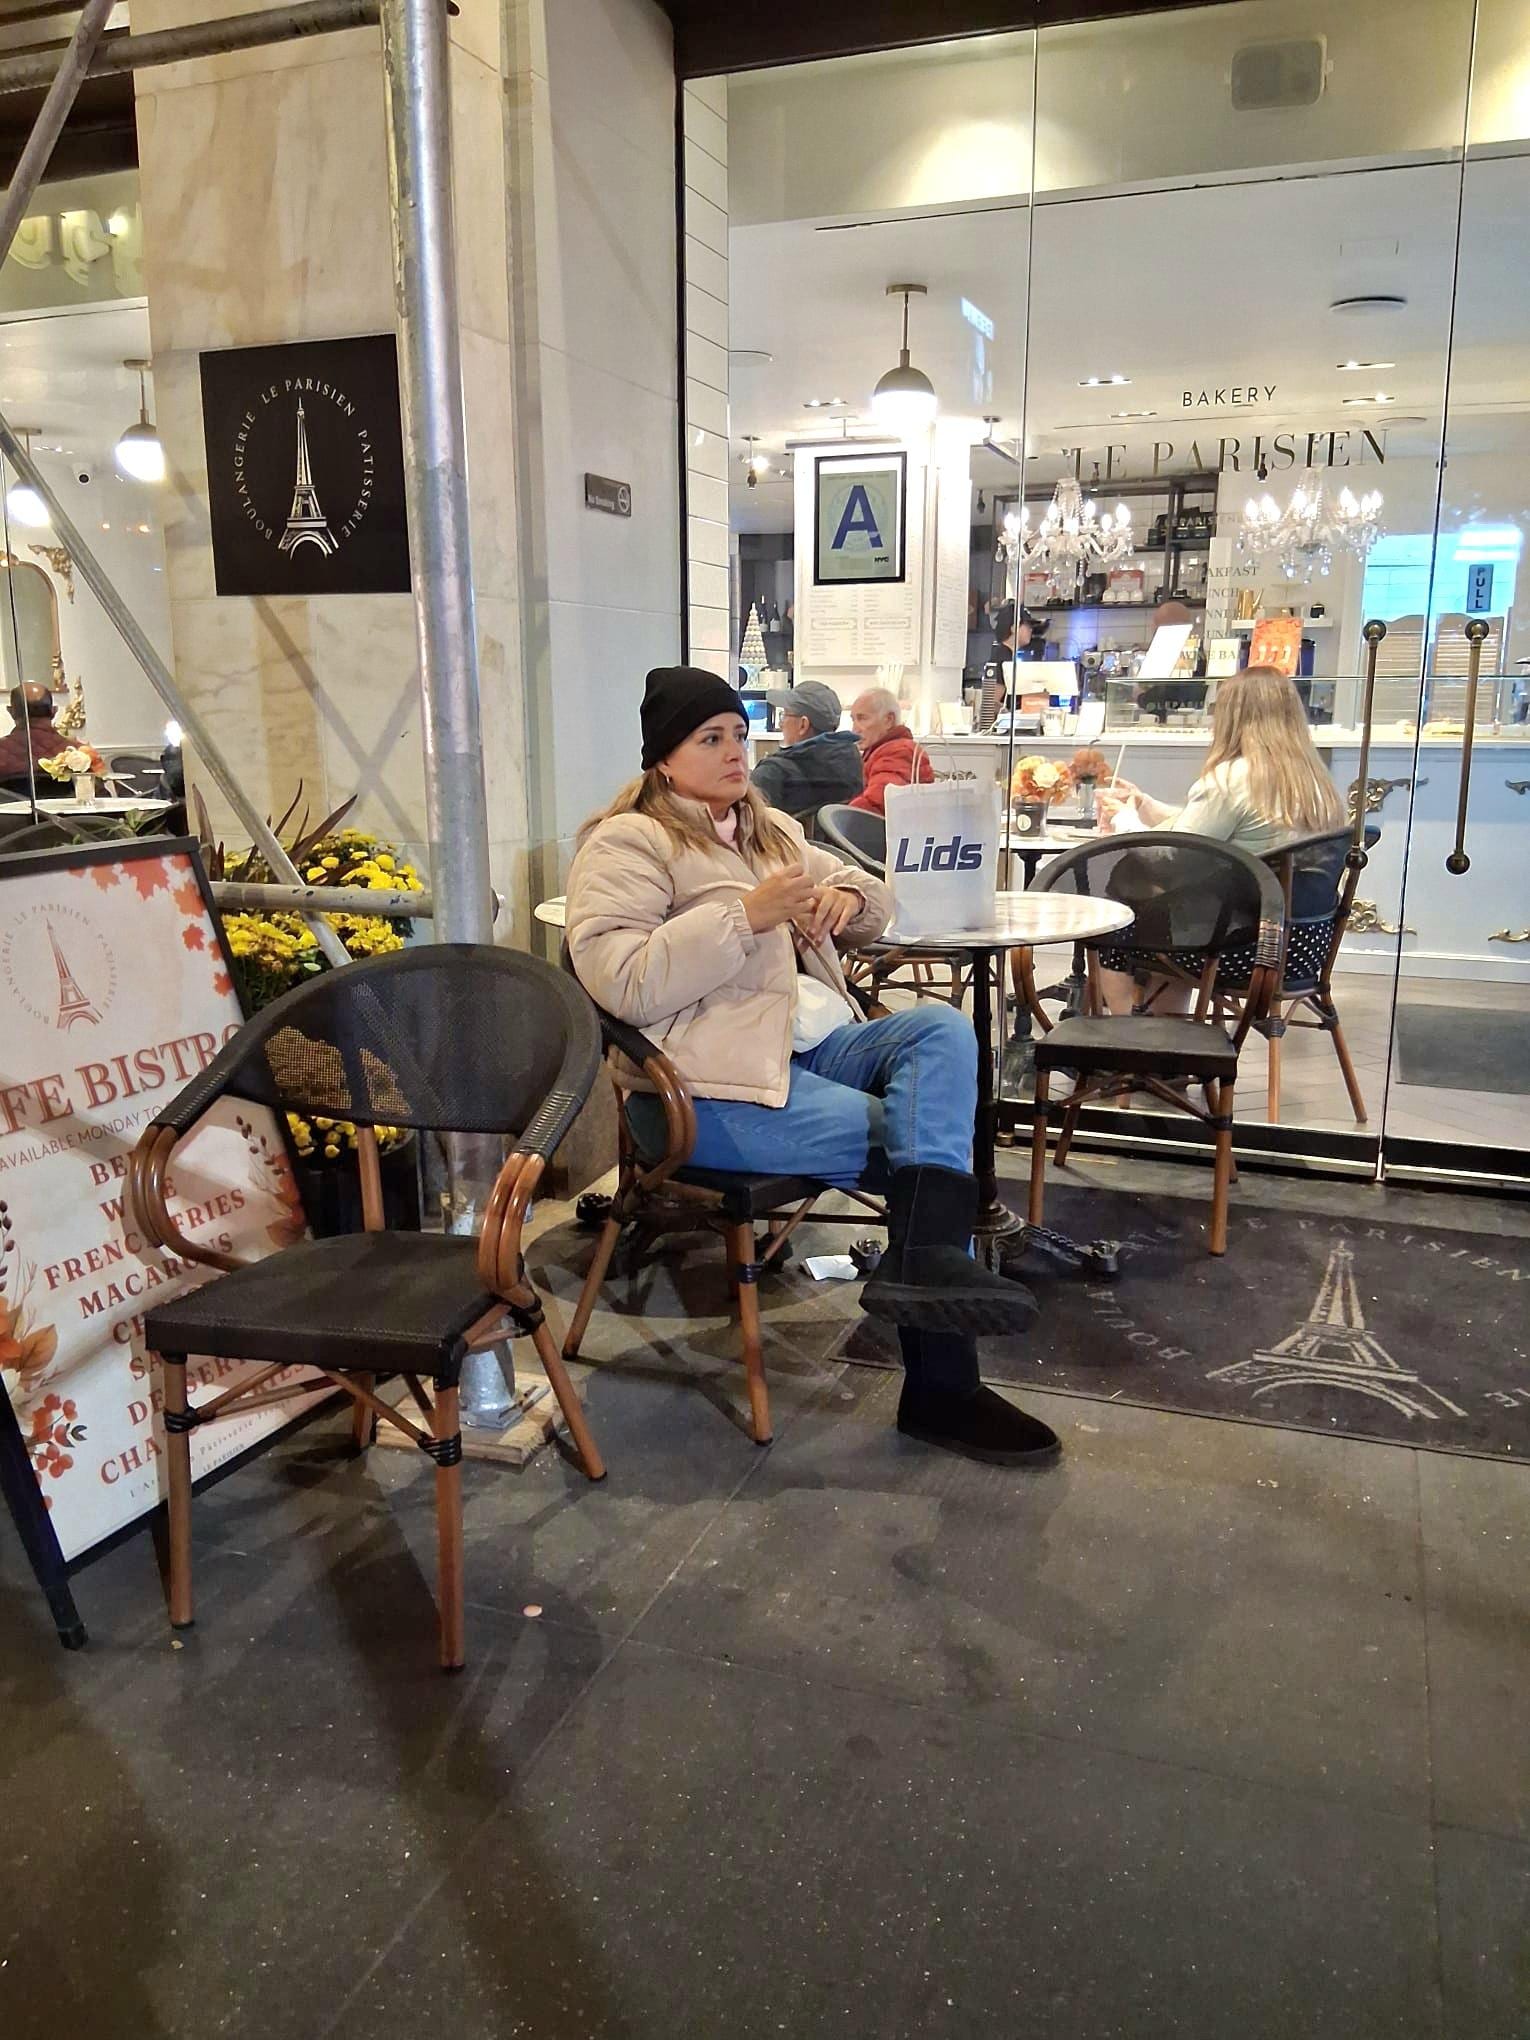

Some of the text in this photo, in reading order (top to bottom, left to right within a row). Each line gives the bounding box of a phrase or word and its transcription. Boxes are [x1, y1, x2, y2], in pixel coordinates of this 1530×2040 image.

[261, 377, 356, 417] LE PARISIEN
[1182, 385, 1278, 408] BAKERY
[234, 411, 274, 540] BOULANGERIE
[1072, 428, 1391, 481] LE PARISIEN
[341, 429, 374, 538] PATISSERIE
[831, 484, 883, 550] A
[1475, 567, 1486, 609] PULL
[894, 835, 983, 873] Lids
[0, 1134, 76, 1172] AVAILABLE
[78, 1111, 140, 1145] MONDAY
[44, 1188, 245, 1291] FRENC FRIES
